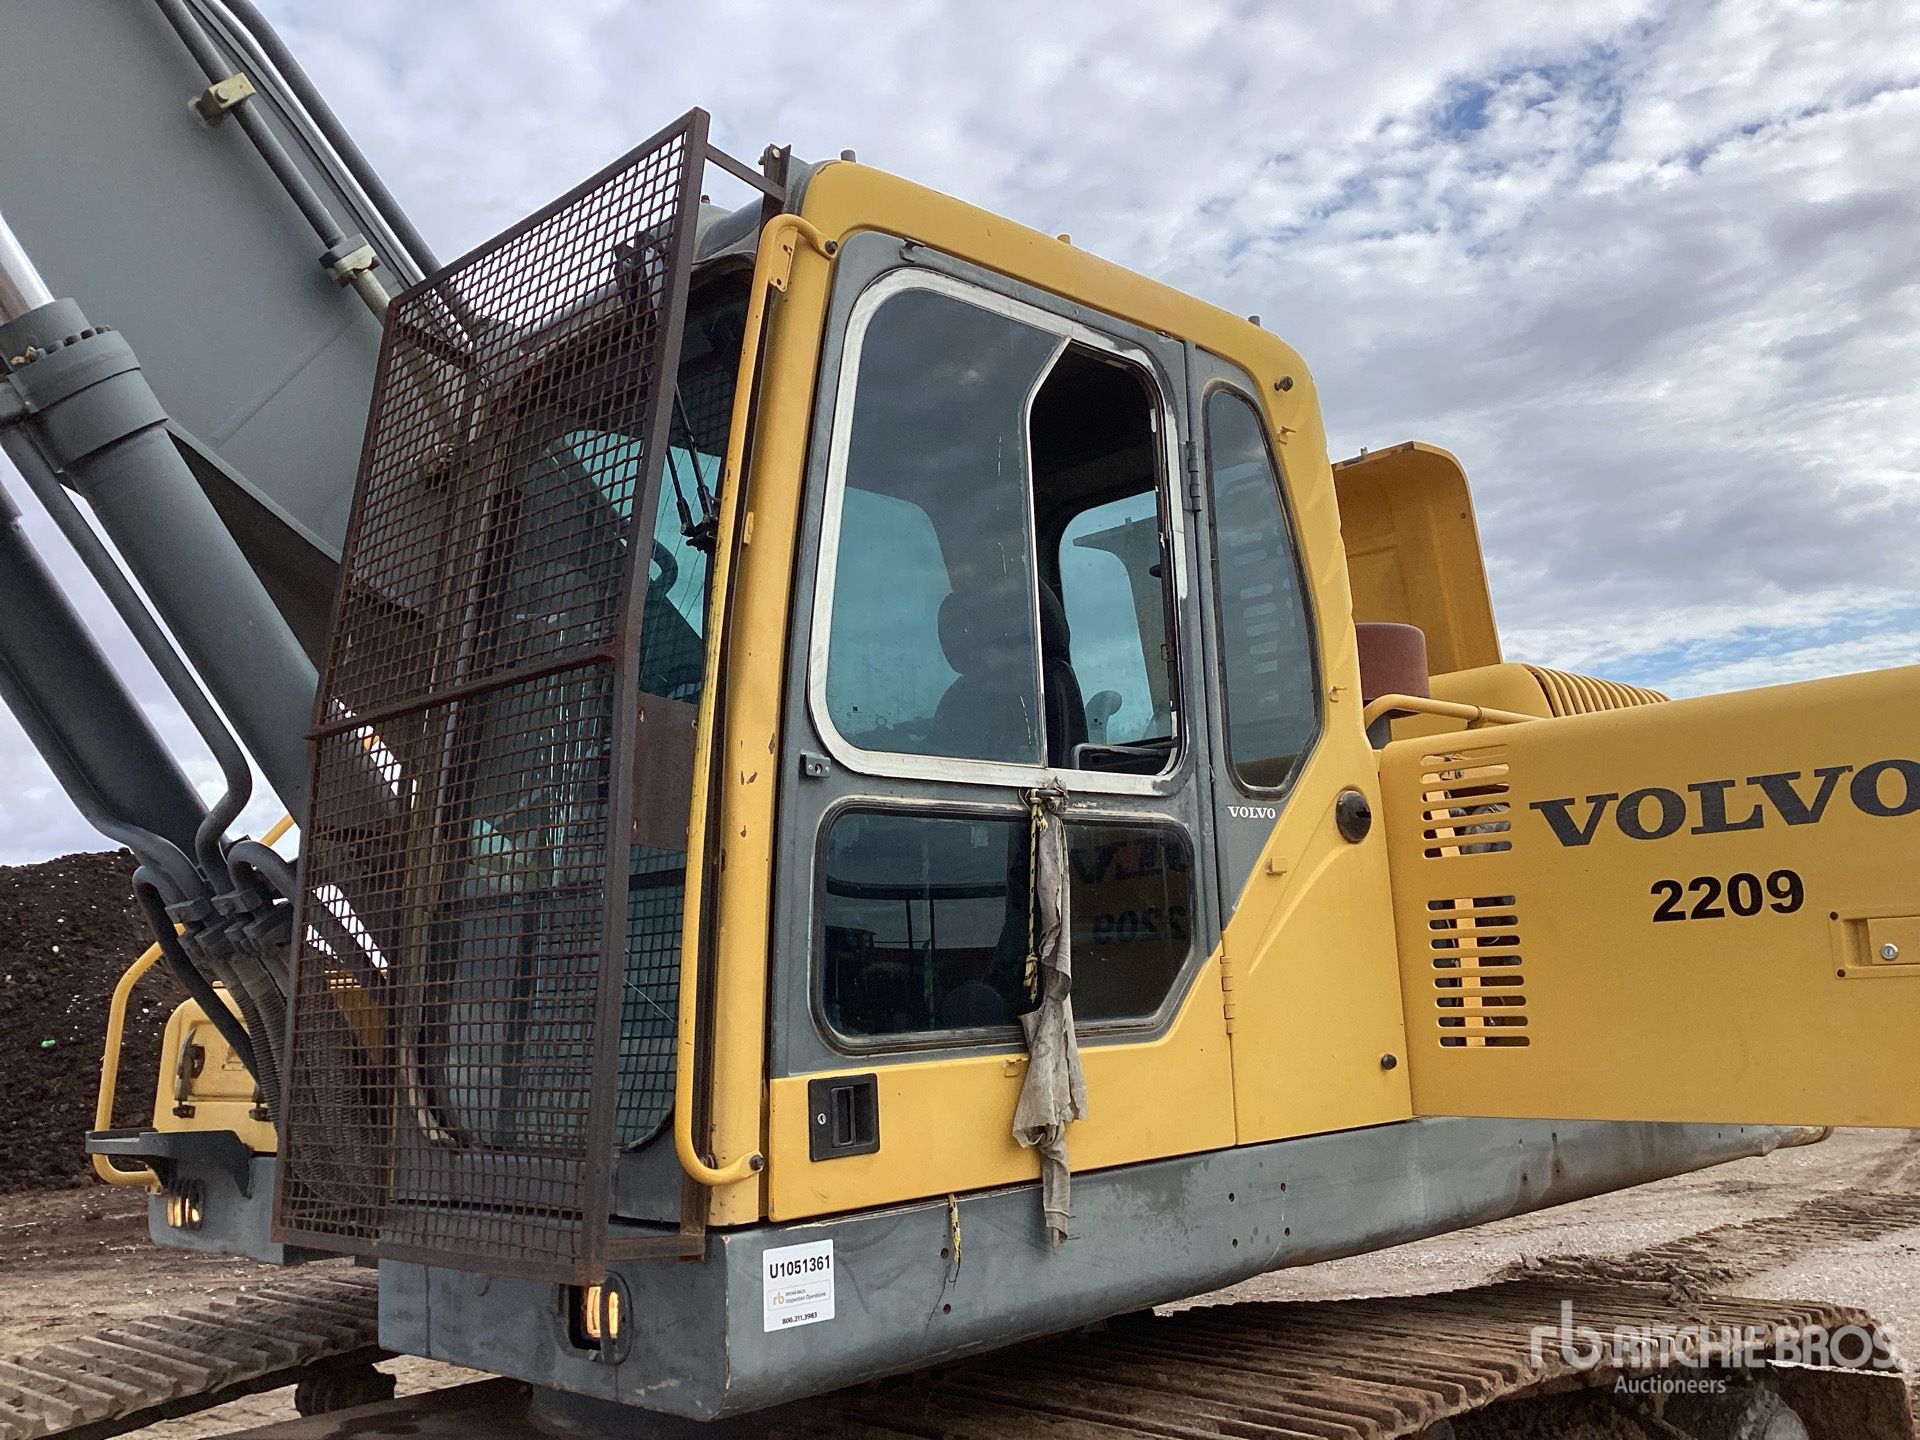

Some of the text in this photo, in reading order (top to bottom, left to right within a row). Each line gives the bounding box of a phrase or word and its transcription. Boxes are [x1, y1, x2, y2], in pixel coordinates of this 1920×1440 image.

[1227, 805, 1276, 819] VOLVO
[1529, 759, 1920, 847] VOLVO
[1650, 869, 1805, 922] 2209
[770, 1254, 830, 1278] U1051361
[806, 1292, 826, 1300] Operations
[782, 1312, 818, 1324] 800.211.3983
